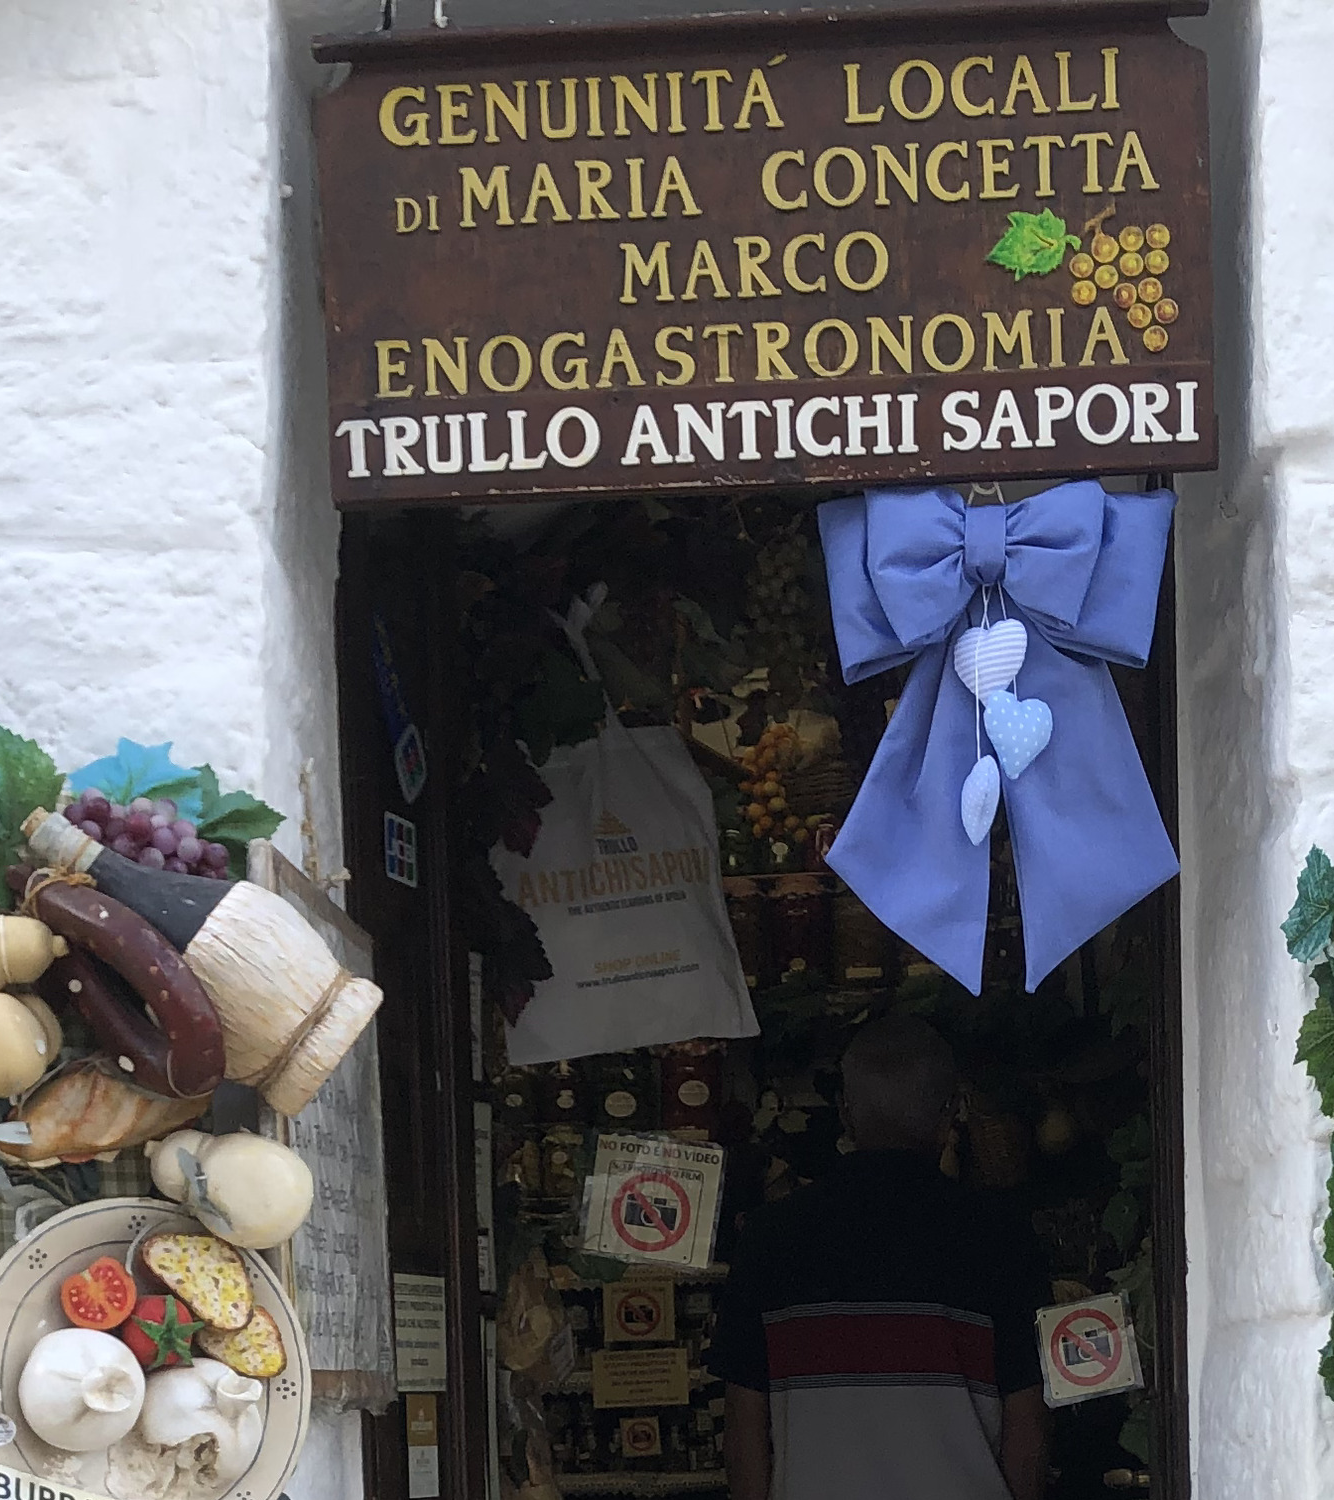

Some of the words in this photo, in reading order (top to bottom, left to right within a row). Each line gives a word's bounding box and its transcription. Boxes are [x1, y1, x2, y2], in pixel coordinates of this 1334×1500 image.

[843, 47, 1120, 124] LOCALI
[395, 196, 439, 234] DI
[459, 156, 702, 229] MARIA
[761, 131, 1160, 211] CONCETTA
[619, 231, 889, 305] MARCO
[375, 306, 1130, 398] ENOGASTRONOMIA
[335, 404, 601, 479] TRULLO
[621, 394, 919, 467] ANTICHI
[942, 382, 1201, 452] SAPORI
[595, 958, 631, 973] SHOP
[620, 1141, 650, 1155] FOTO
[684, 1151, 720, 1165] VIDEO
